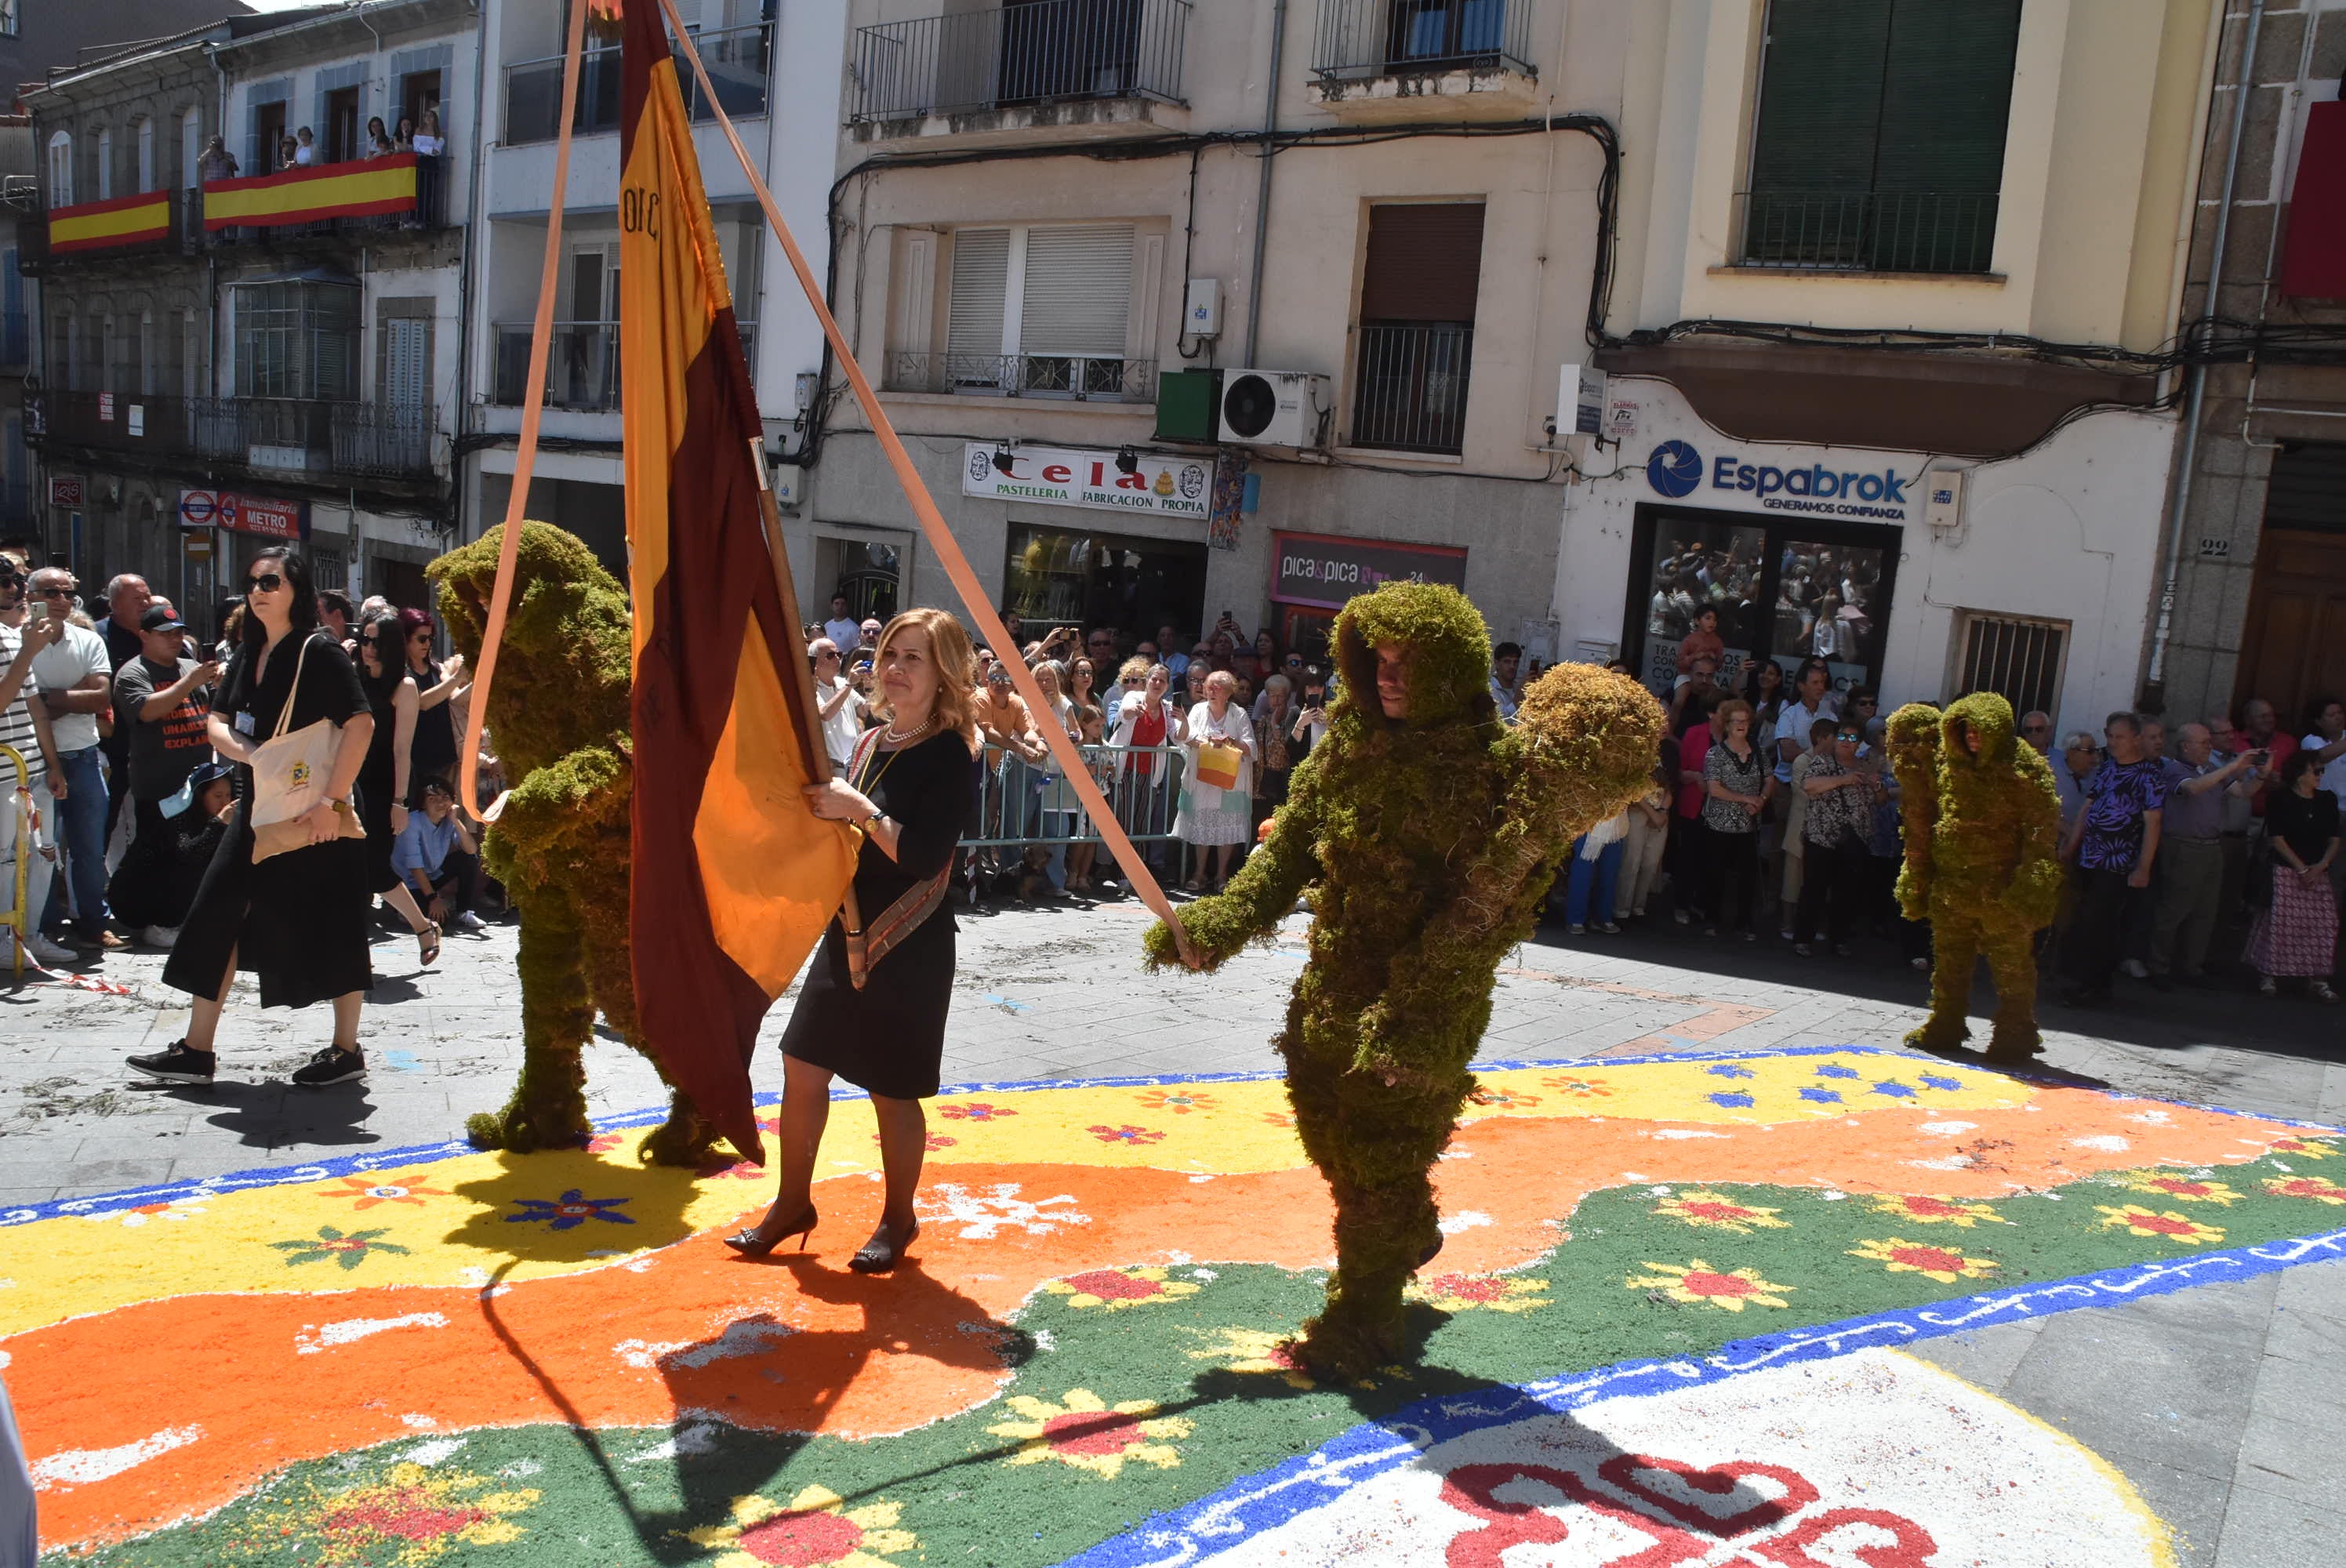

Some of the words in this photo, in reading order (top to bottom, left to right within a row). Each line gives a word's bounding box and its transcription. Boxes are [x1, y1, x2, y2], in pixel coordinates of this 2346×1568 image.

[1712, 456, 1907, 503] Espabrok
[996, 484, 1069, 499] PASTELERIA
[239, 496, 297, 515] Inmobiliaria
[1082, 491, 1153, 508] FABRICACION
[1160, 499, 1204, 514] PROPIA
[1763, 498, 1835, 514] GENERAMOS
[1836, 504, 1905, 520] CONFIANZA
[247, 510, 287, 528] METRO
[2201, 539, 2228, 556] 22
